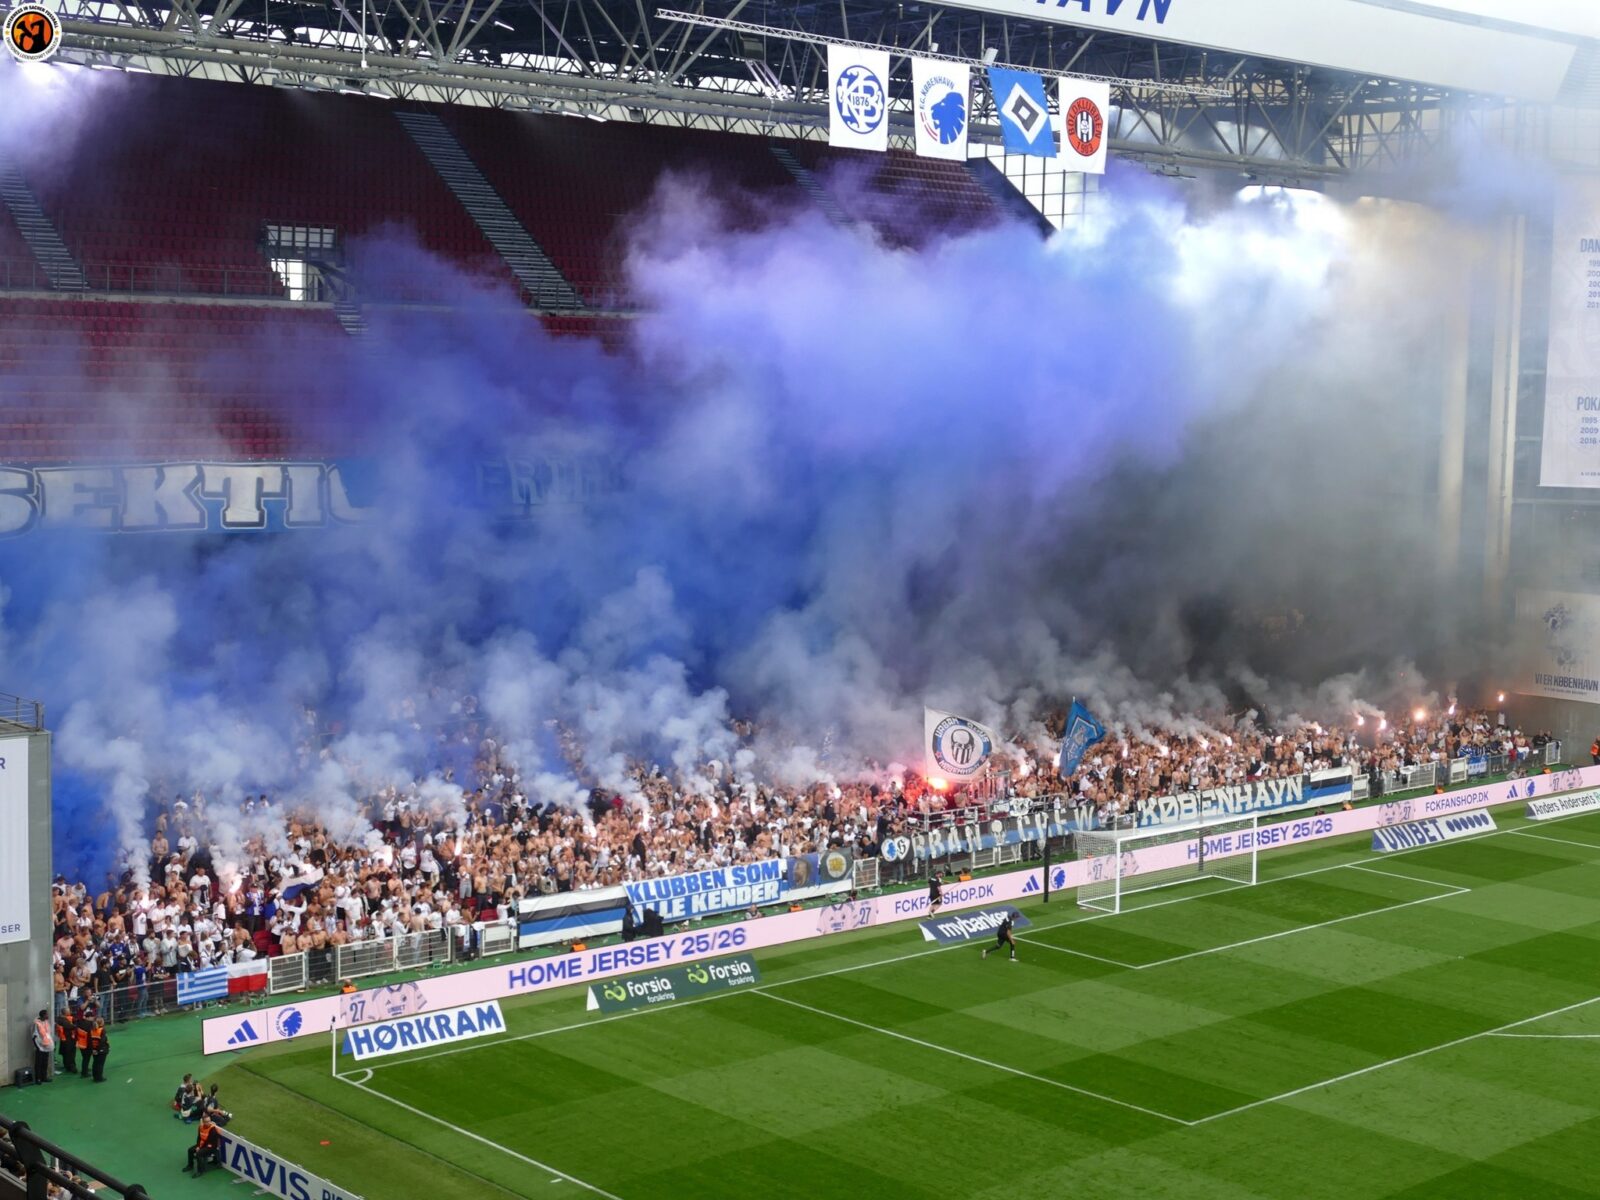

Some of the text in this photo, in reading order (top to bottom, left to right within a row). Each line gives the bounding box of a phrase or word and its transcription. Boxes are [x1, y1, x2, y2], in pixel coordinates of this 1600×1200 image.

[852, 95, 870, 107] 1876
[1067, 99, 1103, 139] BOLDKLUBBEN
[1577, 396, 1600, 412] POK
[1553, 675, 1599, 693] KØBENHAVN
[1138, 776, 1303, 826] KØBENHAVN
[1425, 791, 1489, 812] FCKFANSHOP.DK
[1533, 801, 1560, 816] Anders
[1187, 818, 1333, 859] HOME JERSEY 25/26
[1384, 818, 1445, 851] UNIBET
[626, 860, 780, 903] KLUBBEN SOM
[691, 881, 780, 914] KENDER
[895, 883, 994, 914] FCKFASHOP.DK
[509, 927, 746, 989] HOME JERSEY 25/26
[709, 960, 752, 980] forsia
[728, 974, 755, 986] forsikring
[626, 976, 672, 998] forsia
[647, 991, 676, 1004] forsikring
[350, 1000, 366, 1023] 27
[352, 1005, 503, 1053] HØRKRAM
